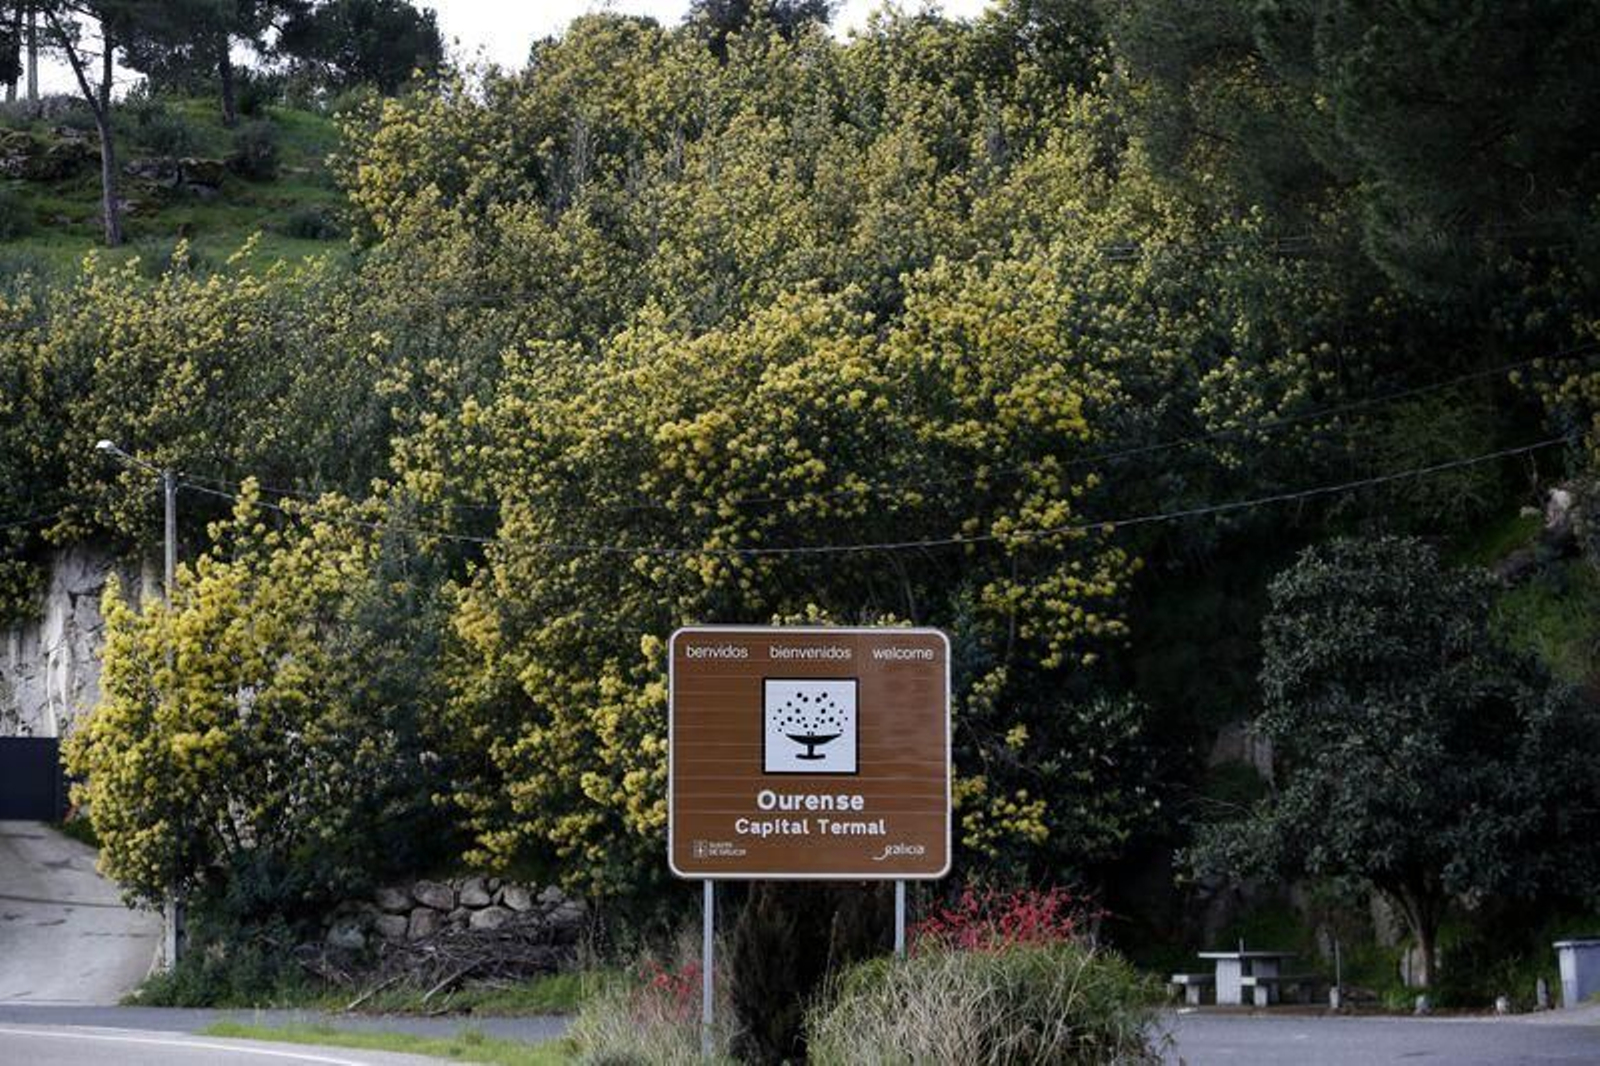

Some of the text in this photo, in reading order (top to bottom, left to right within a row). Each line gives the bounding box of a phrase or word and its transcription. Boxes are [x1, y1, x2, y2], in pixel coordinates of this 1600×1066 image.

[686, 645, 749, 659] benvidos
[769, 645, 852, 660] bienvenidos
[872, 646, 935, 660] welcome
[756, 789, 865, 811] Ourense
[734, 818, 887, 838] Capital Termal
